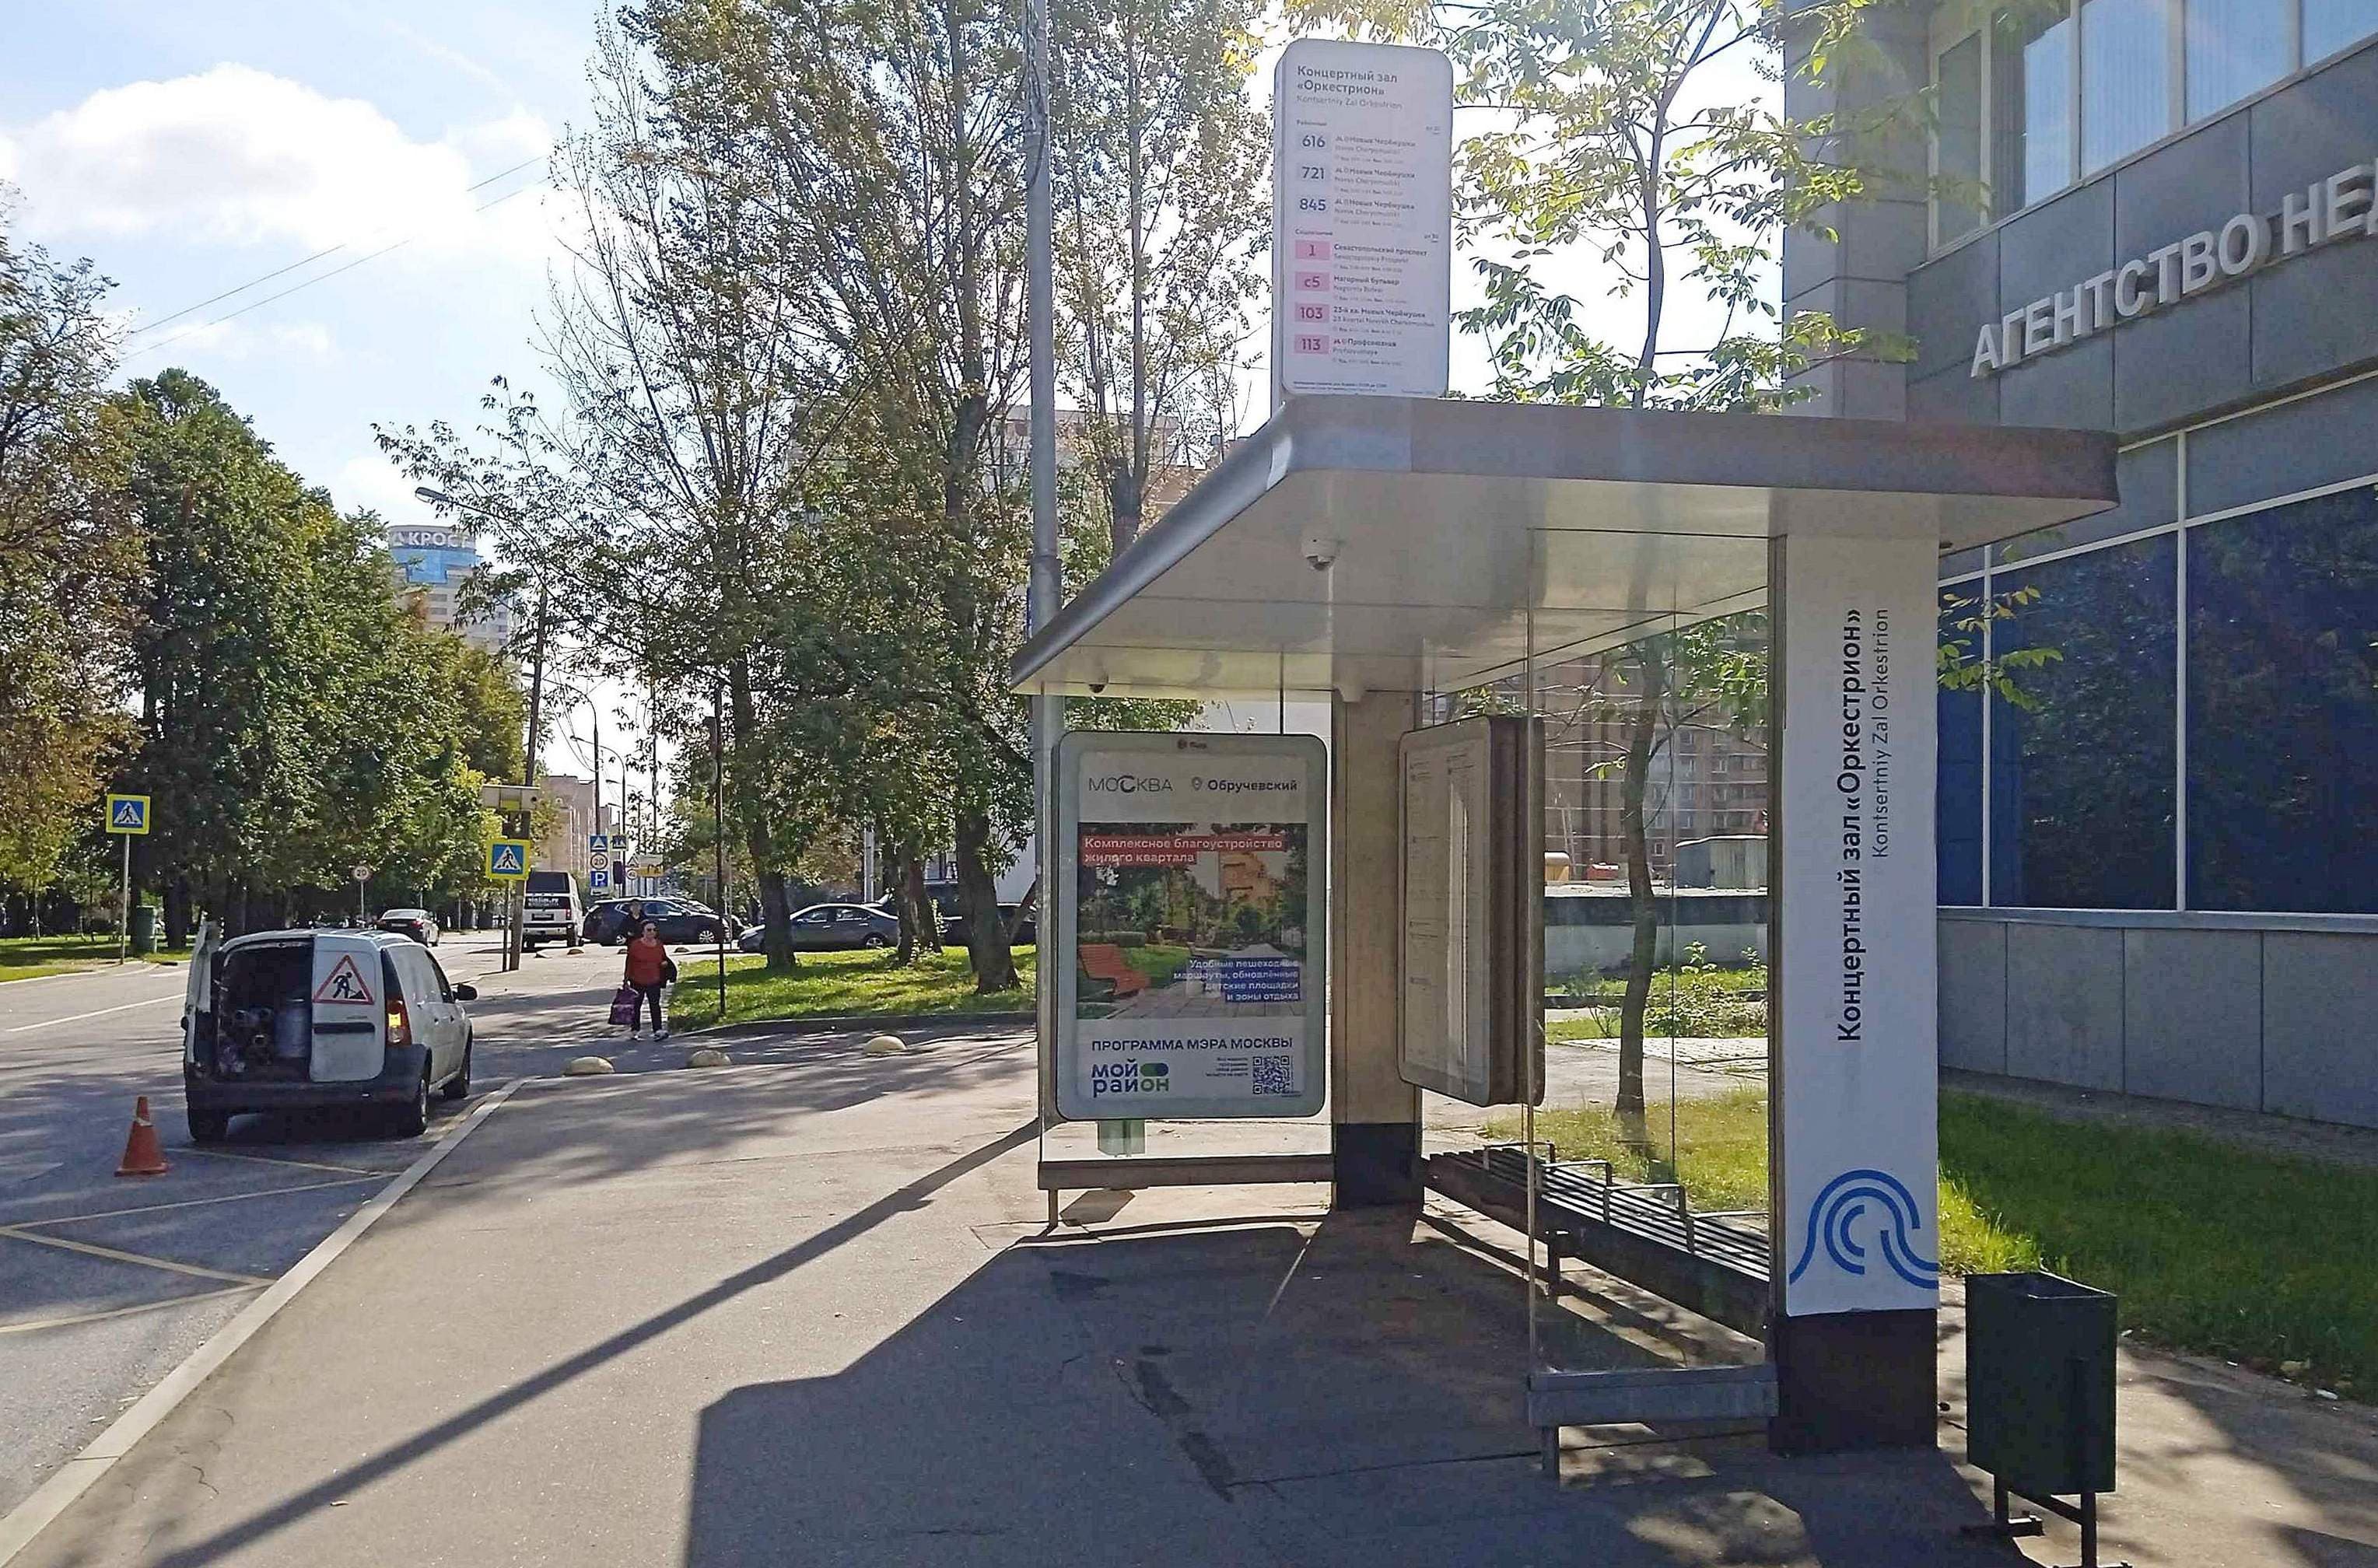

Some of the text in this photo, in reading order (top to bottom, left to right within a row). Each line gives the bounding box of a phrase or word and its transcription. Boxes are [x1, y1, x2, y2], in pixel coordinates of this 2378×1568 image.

[1297, 65, 1398, 83] Концертный зал
[1297, 79, 1385, 95] «Оркестрион»
[1302, 135, 1326, 148] 616
[1301, 166, 1325, 180] 721
[1299, 198, 1326, 211] 845
[1308, 243, 1316, 257] 1
[1970, 213, 2262, 379] АГЕНТСТВО
[1300, 306, 1323, 320] 103
[1301, 338, 1321, 351] 113
[1872, 609, 1892, 857] Kontsertniy Zal Orkestrion
[1088, 775, 1174, 793] МОСКВА
[1207, 779, 1298, 793] Обручевский
[1837, 609, 1866, 1041] Концертный зал «Оркестрион»
[1084, 837, 1283, 852] Комплексное благоустройство
[1084, 853, 1195, 864] жилого квартала
[1249, 982, 1298, 990] площадки
[1091, 1038, 1294, 1051] ПРОГРАММА МЭРА МОСКВЫ
[1091, 1058, 1138, 1078] мой
[1093, 1078, 1169, 1098] район
